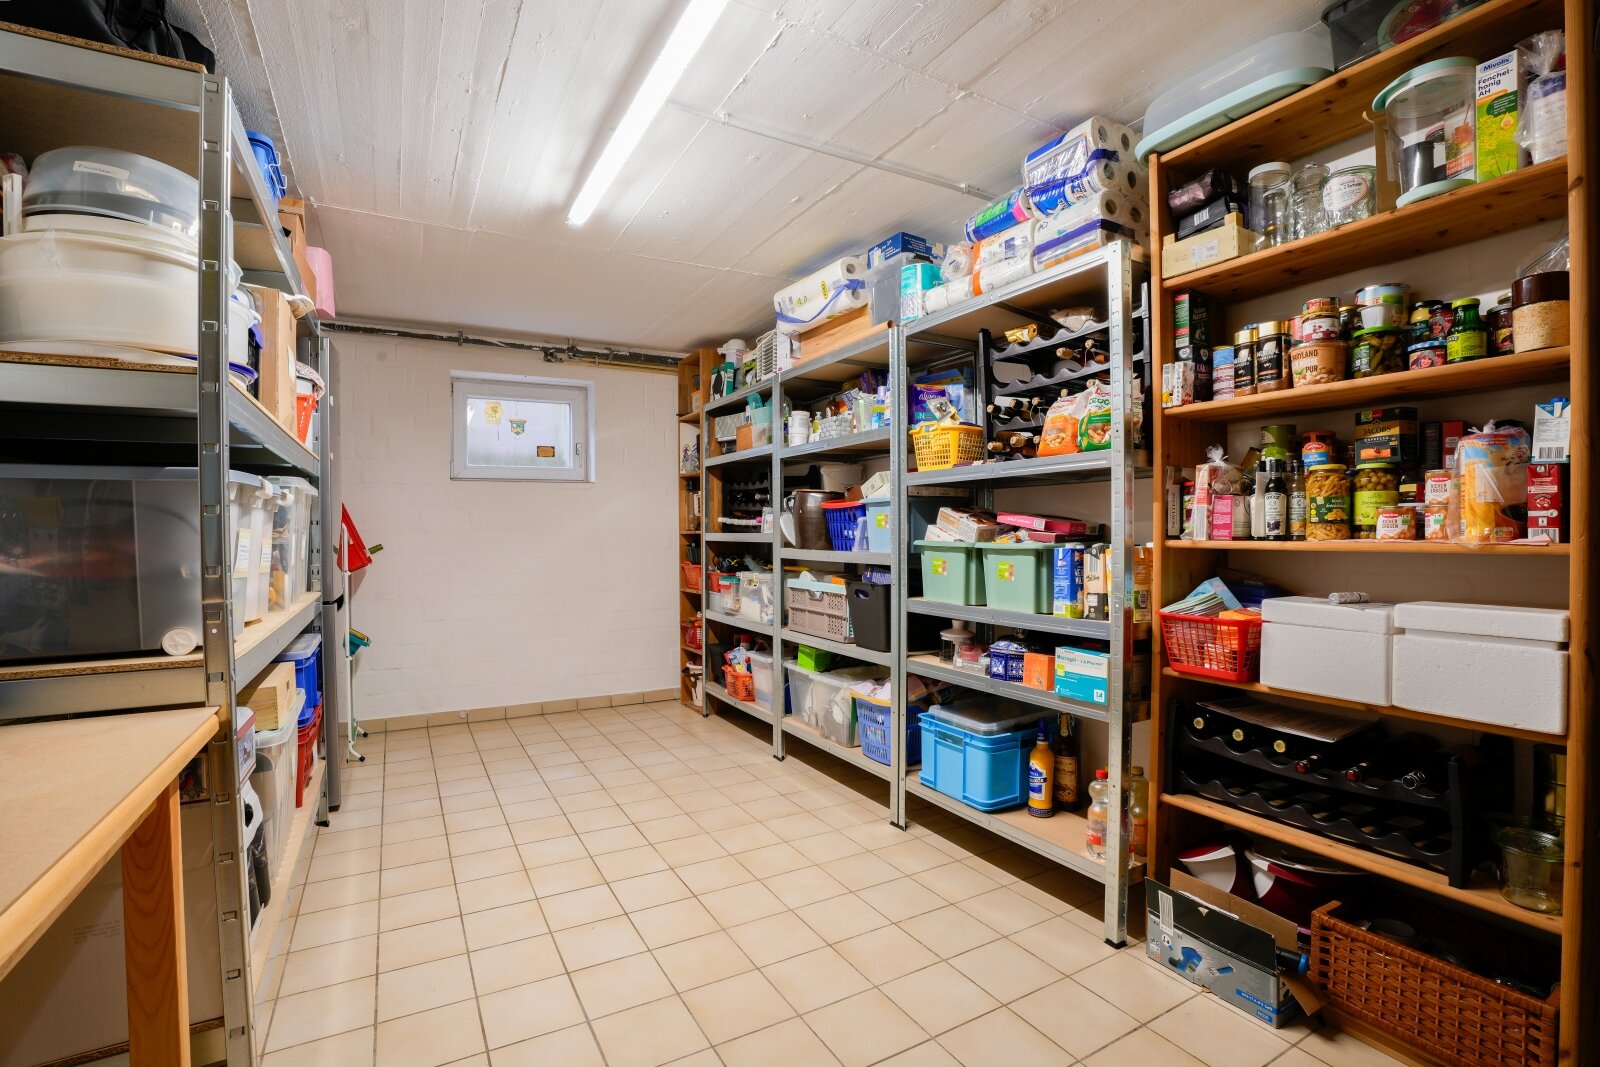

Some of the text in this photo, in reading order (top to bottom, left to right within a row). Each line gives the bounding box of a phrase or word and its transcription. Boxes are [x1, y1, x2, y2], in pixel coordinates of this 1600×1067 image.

[1483, 57, 1510, 72] Mivolis
[1478, 68, 1514, 86] Fenchel-
[1478, 80, 1501, 92] honig
[1478, 88, 1491, 98] AH
[1305, 365, 1318, 374] PUR
[1363, 425, 1392, 436] JACOBS
[1056, 654, 1077, 663] Macrogel
[1095, 691, 1104, 699] 14
